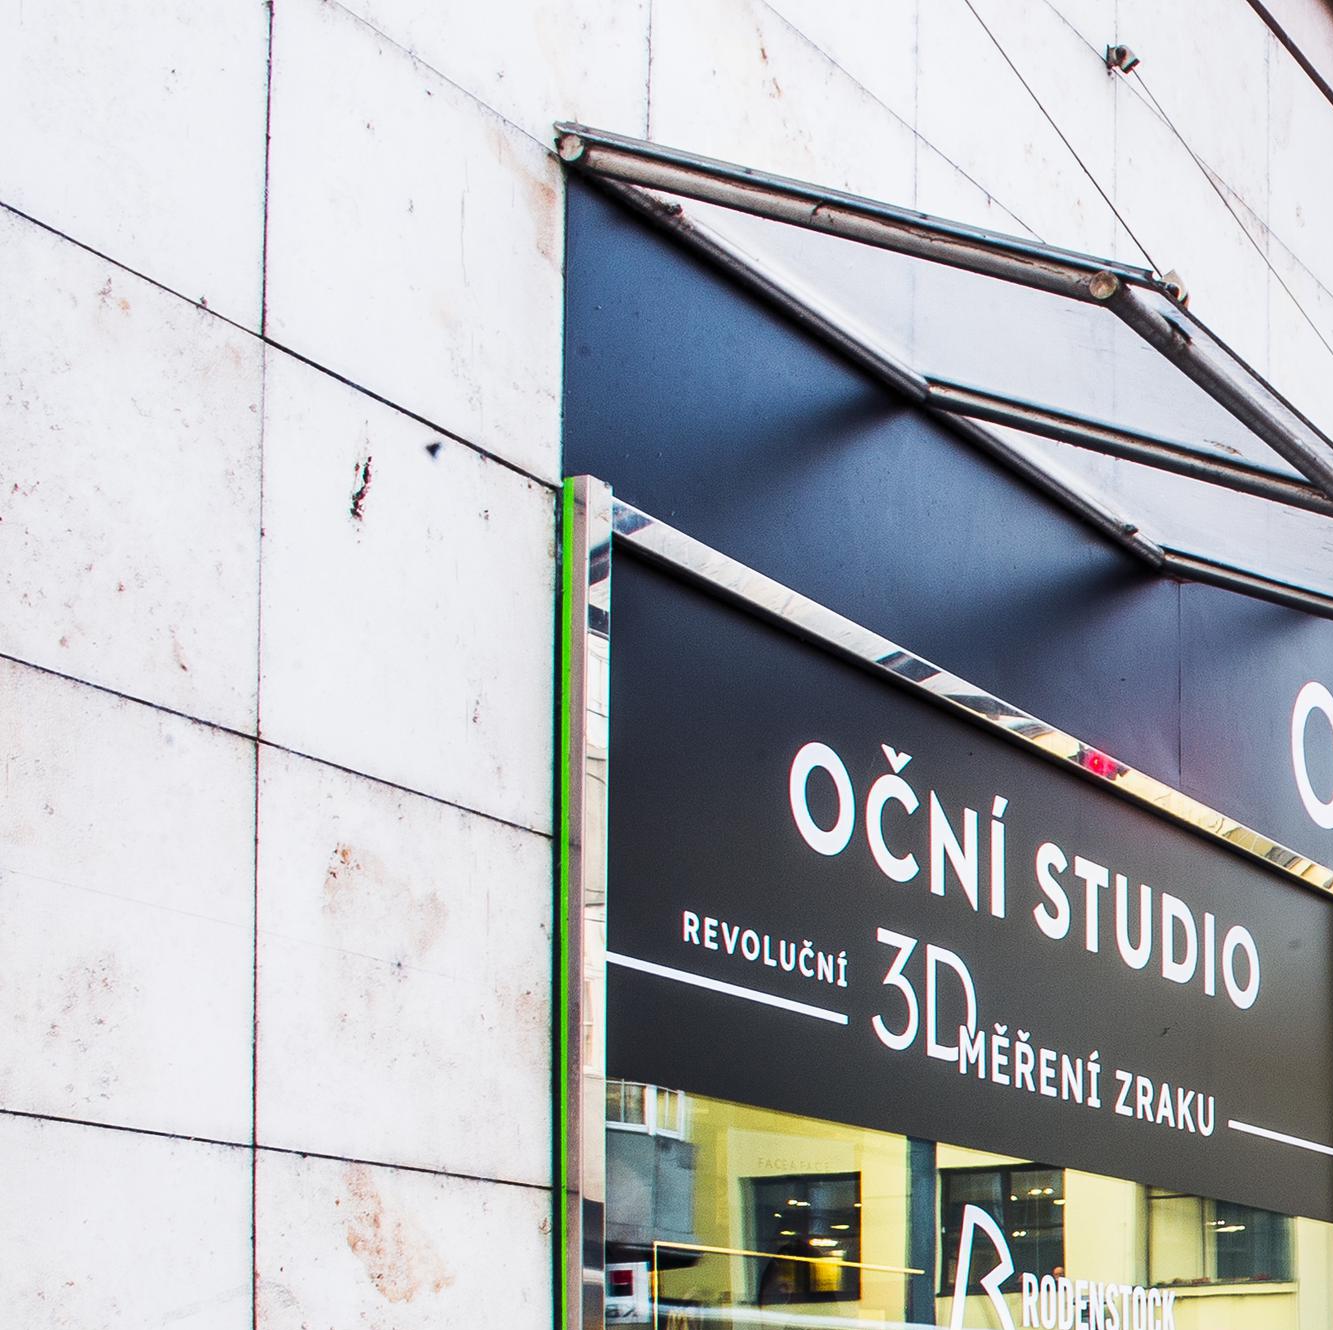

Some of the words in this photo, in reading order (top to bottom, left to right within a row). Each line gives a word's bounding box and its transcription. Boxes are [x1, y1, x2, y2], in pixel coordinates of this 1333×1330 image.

[683, 911, 848, 988] REVOLUČNÍ
[789, 741, 1006, 918] OČNÍ
[1035, 842, 1261, 1010] STUDIO
[872, 927, 977, 1061] 3D
[958, 1024, 1101, 1109] MĚŘENÍ
[1115, 1068, 1216, 1138] ZRAKU
